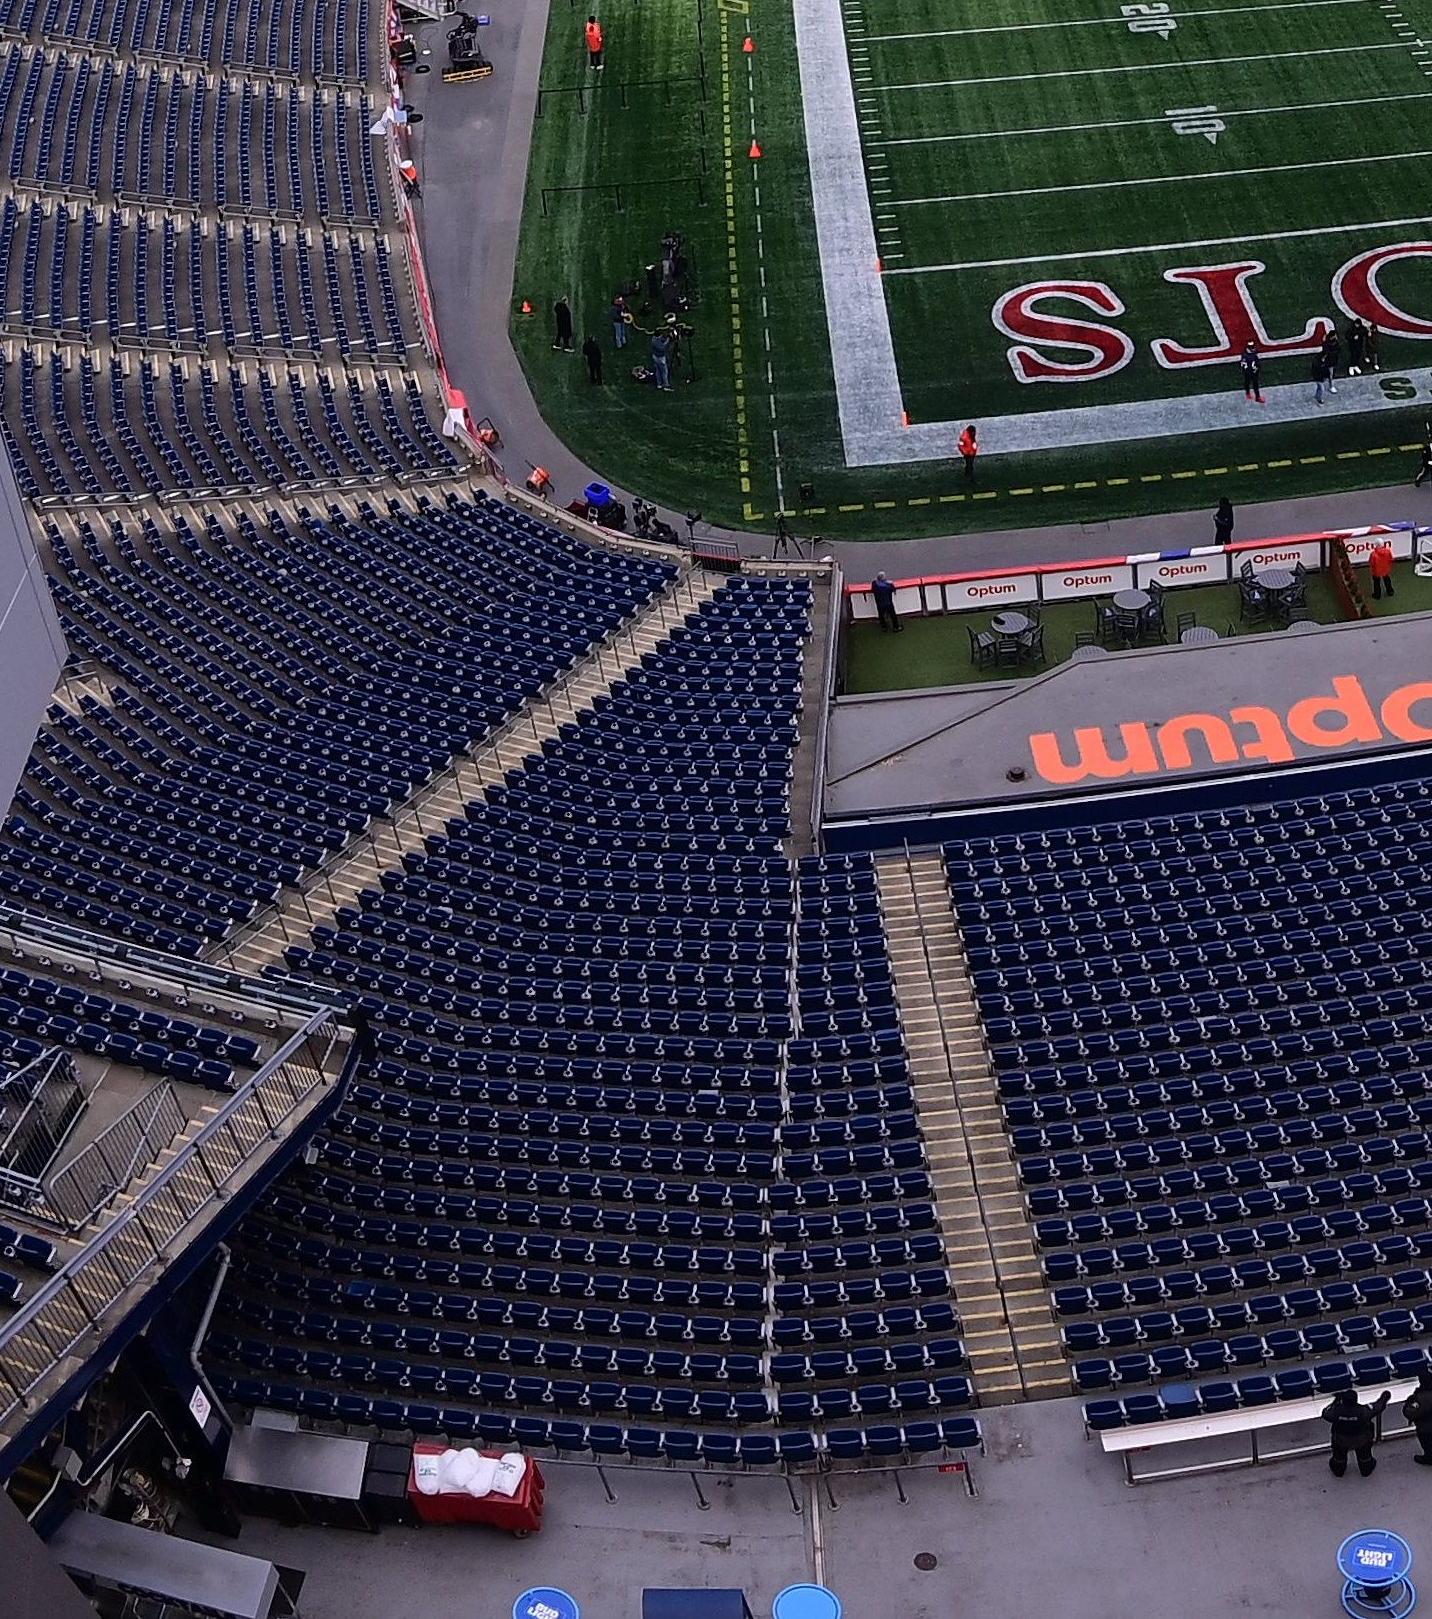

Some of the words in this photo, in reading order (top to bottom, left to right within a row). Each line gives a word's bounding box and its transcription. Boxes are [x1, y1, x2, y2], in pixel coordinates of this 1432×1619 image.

[1120, 2, 1178, 34] 20
[1345, 537, 1392, 554] Optm
[1253, 550, 1300, 569] Optum
[1158, 562, 1207, 581] Optum
[967, 582, 1016, 600] Optum
[1063, 573, 1112, 591] Optum
[1356, 1549, 1393, 1561] LIGHT
